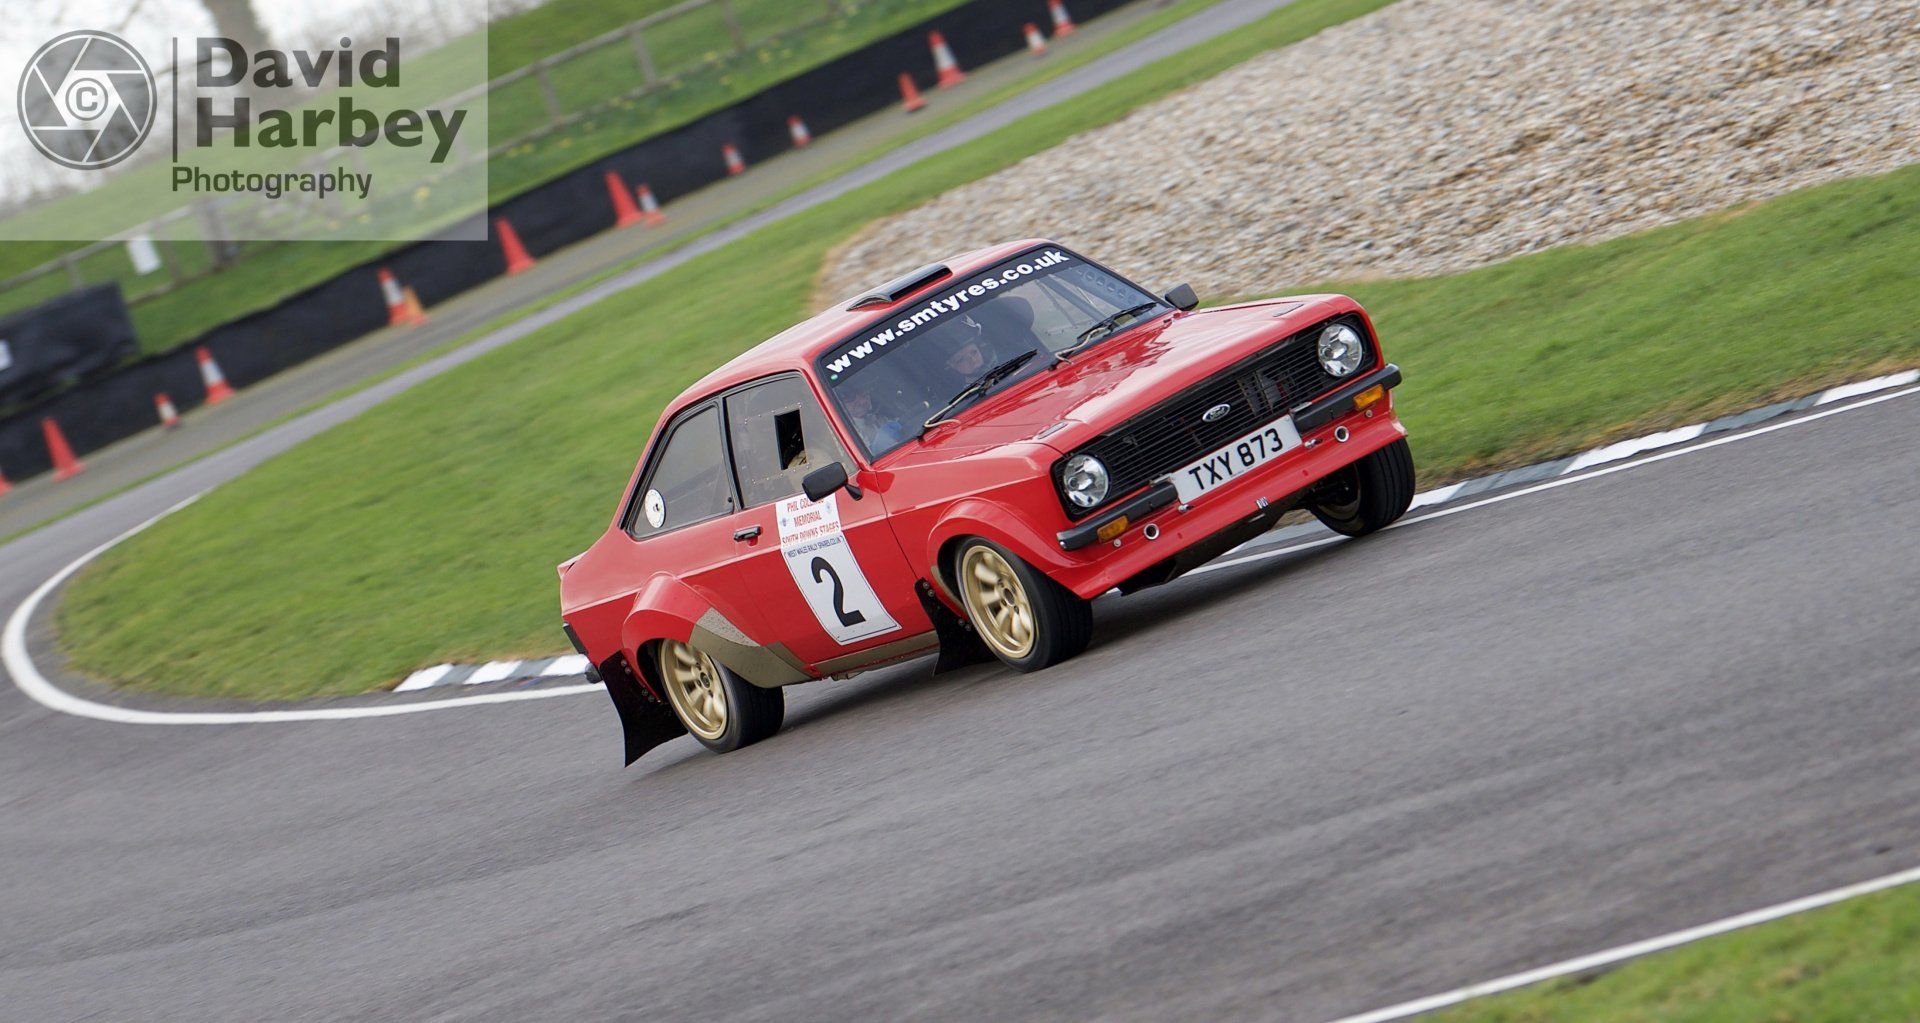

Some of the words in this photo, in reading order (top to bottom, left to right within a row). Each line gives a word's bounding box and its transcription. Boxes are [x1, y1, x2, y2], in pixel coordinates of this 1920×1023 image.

[826, 249, 1070, 374] www.smtyres.co.uk
[1188, 451, 1233, 490] TXY
[1237, 428, 1283, 467] 873
[793, 510, 822, 527] MEMORIAL
[819, 520, 840, 536] STAGES
[811, 557, 866, 627] 2
